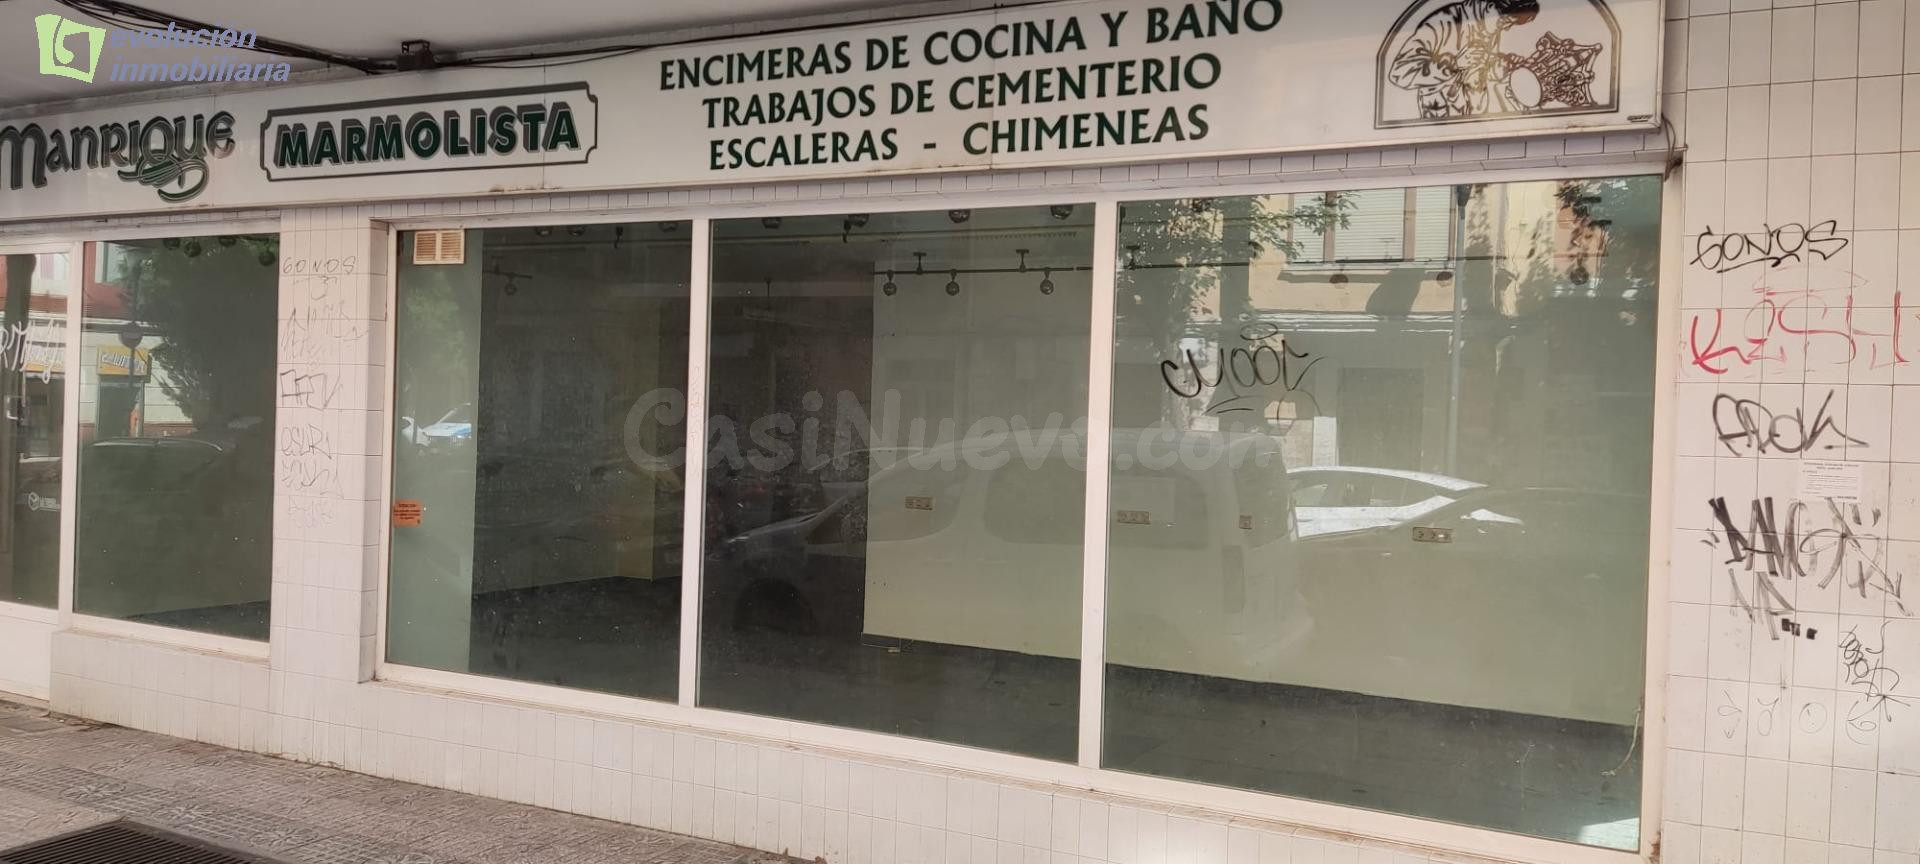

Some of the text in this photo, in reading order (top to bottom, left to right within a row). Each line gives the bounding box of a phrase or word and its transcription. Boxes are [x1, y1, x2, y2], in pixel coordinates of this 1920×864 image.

[660, 41, 851, 91] ENCIMERAS
[866, 35, 910, 72] DE
[923, 16, 1087, 66] COCINA
[1101, 10, 1128, 47] Y
[702, 53, 1221, 128] TRABAJOS DE CEMENTERIO
[273, 101, 581, 168] MARMOLISTA
[710, 128, 898, 170] ESCALERAS
[963, 103, 1209, 155] CHIMENEAS
